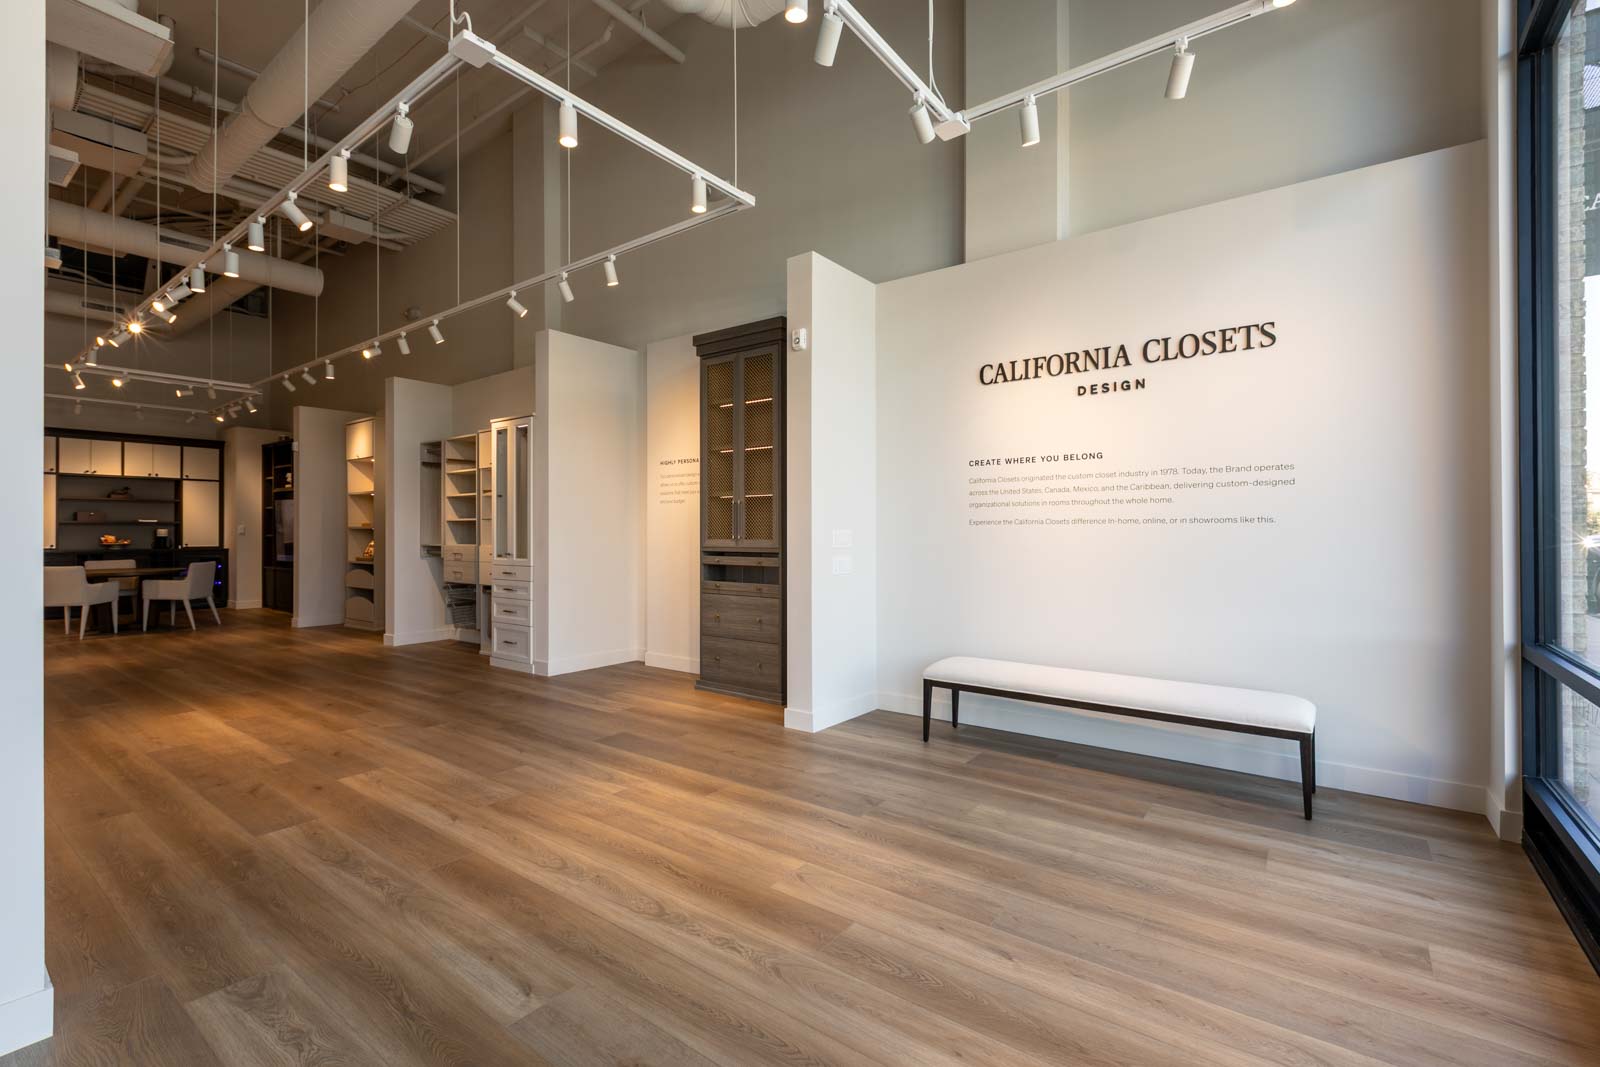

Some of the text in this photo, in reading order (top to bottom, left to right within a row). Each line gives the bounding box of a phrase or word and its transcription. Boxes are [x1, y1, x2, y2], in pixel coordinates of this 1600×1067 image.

[979, 321, 1277, 386] CALIFORNIA CLOSETS
[1077, 378, 1146, 396] DESIGN
[968, 452, 1104, 467] CREATE WHERE YOU BELONG
[968, 476, 997, 485] California
[997, 474, 1020, 484] Closets
[1021, 474, 1054, 483] originated
[1055, 472, 1067, 480] the
[1067, 472, 1094, 480] custom
[1094, 471, 1117, 479] closet
[1118, 469, 1149, 478] industry
[1159, 467, 1179, 476] 1978.
[1182, 467, 1208, 476] Today,
[1225, 464, 1252, 473] Brand
[1253, 463, 1295, 473] operates
[988, 488, 999, 496] the
[999, 487, 1021, 495] United
[1072, 485, 1101, 493] Mexico,
[1101, 484, 1115, 492] and
[1129, 482, 1172, 491] Caribbean,
[1173, 482, 1214, 490] delivering
[1215, 477, 1296, 488] custom-designed
[968, 500, 1011, 509] organizational
[1071, 498, 1110, 507] throughout
[1125, 497, 1149, 505] whole
[1149, 496, 1174, 504] home.
[968, 518, 1003, 527] Experience
[1002, 518, 1013, 526] the
[1013, 518, 1044, 526] California
[1045, 518, 1070, 526] Closets
[1071, 517, 1107, 525] difference
[1142, 517, 1169, 525] online,
[1188, 516, 1238, 525] showrooms
[1239, 516, 1256, 525] like
[1257, 516, 1277, 525] this.
